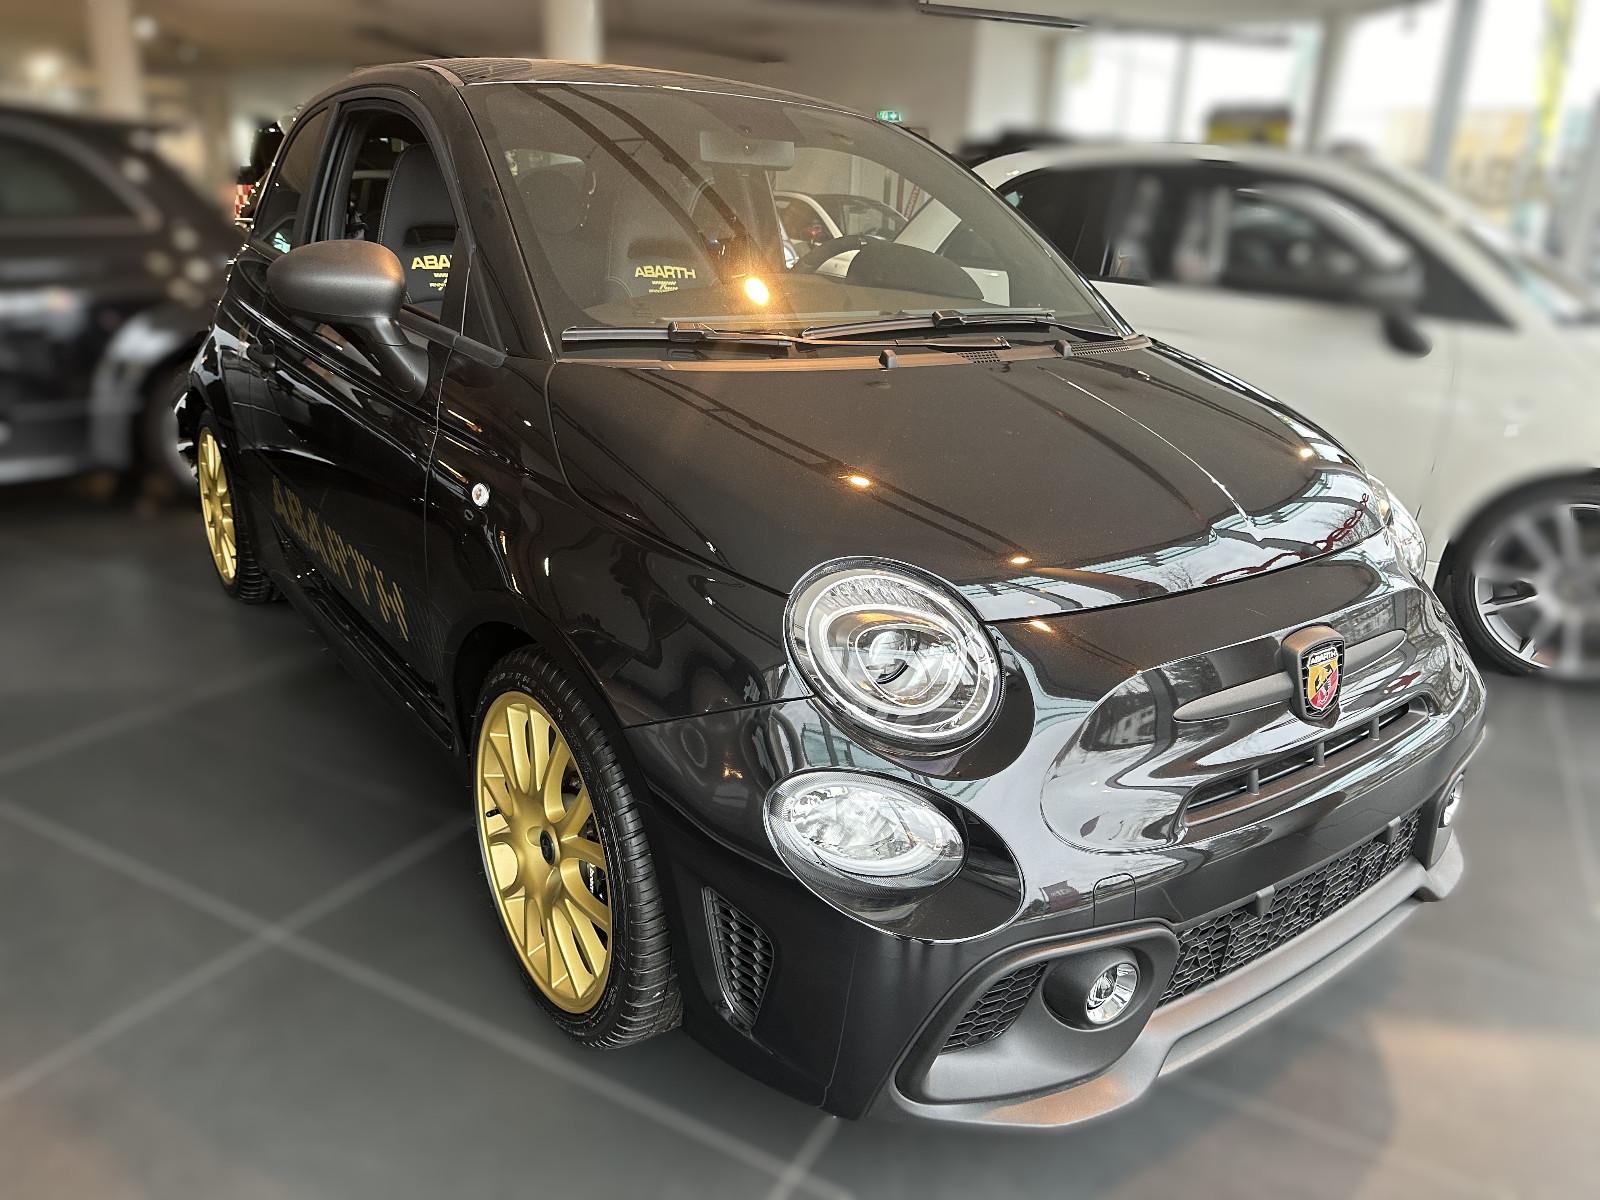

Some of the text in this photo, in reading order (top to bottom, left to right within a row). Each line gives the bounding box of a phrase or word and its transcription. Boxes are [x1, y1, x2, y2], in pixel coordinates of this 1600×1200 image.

[411, 254, 452, 270] ABA
[634, 265, 697, 278] ABARTH
[272, 475, 409, 642] ABARTH
